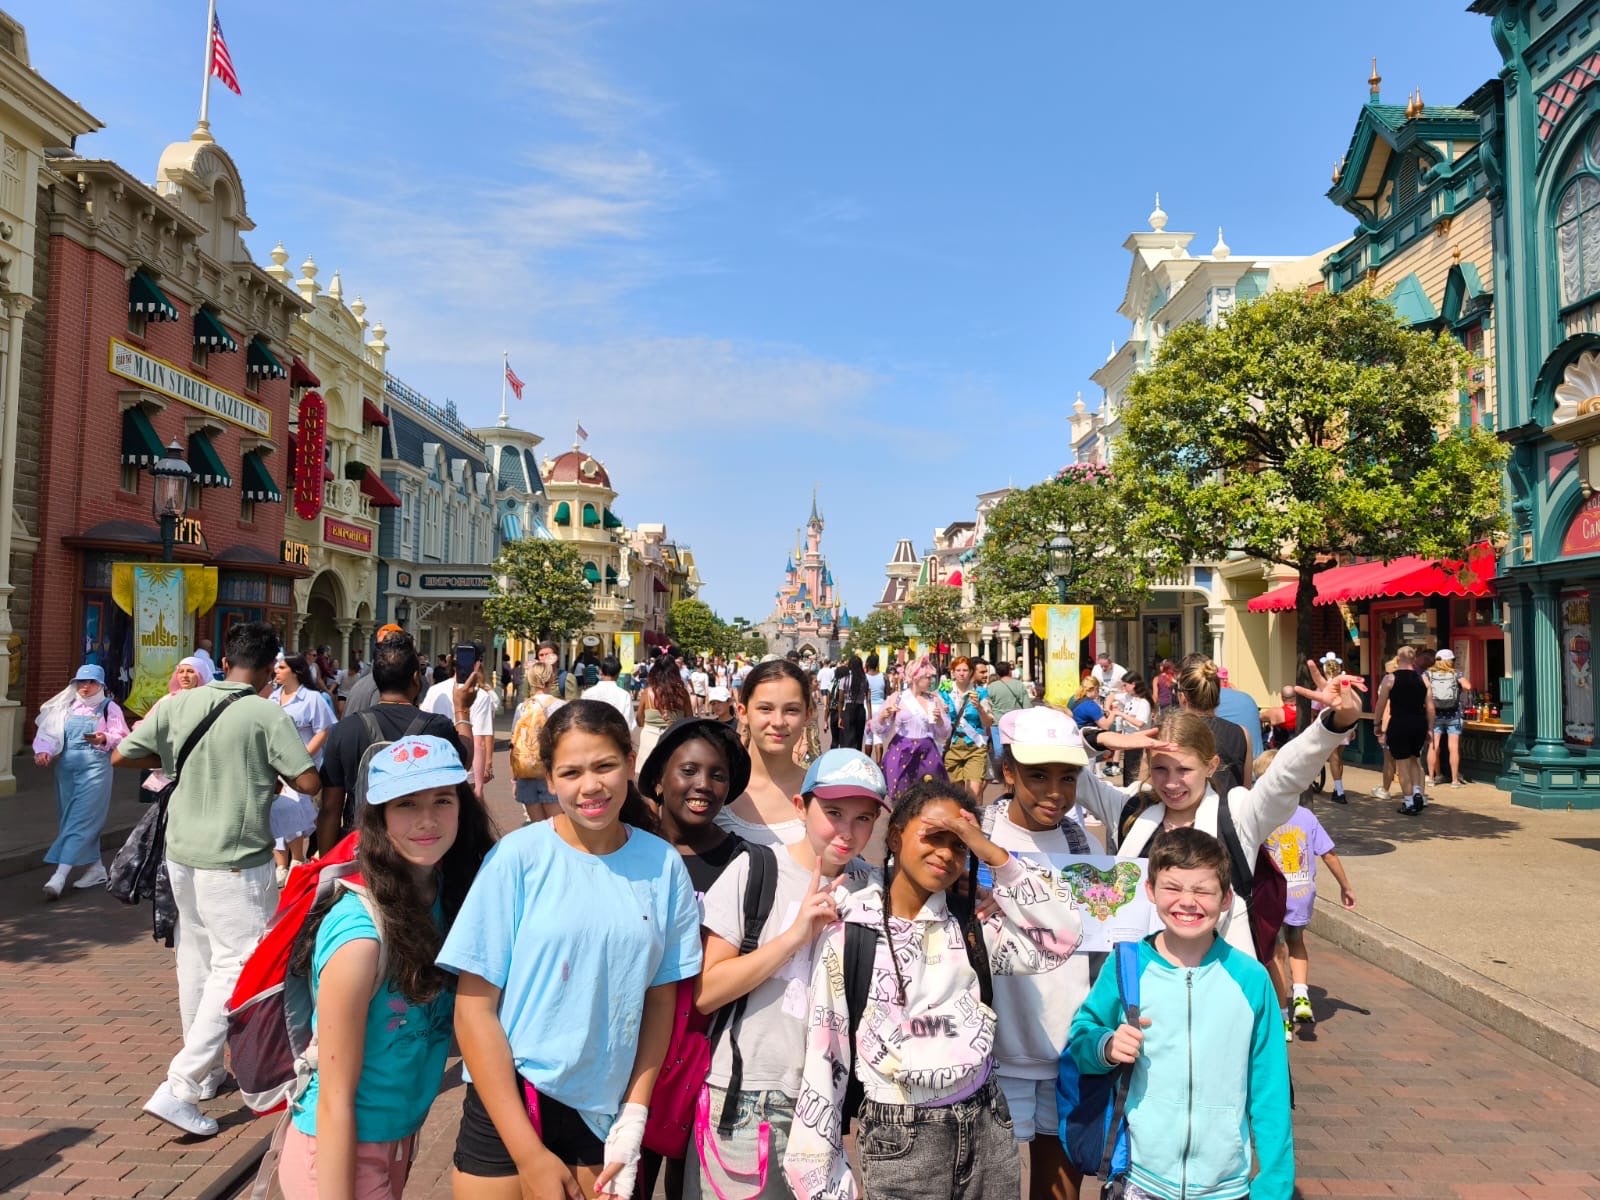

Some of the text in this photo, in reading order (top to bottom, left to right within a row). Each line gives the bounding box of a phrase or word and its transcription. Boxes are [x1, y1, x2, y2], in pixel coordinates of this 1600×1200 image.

[134, 355, 166, 388] MAIN
[169, 370, 211, 407] STREET
[214, 391, 257, 426] GAZETTE
[302, 407, 319, 501] EMPORIUM
[175, 518, 201, 545] IFTS
[331, 525, 368, 545] EMPORIUM
[284, 540, 309, 567] GIFTS
[141, 631, 178, 647] MUSIC
[1052, 650, 1075, 660] MUSIC
